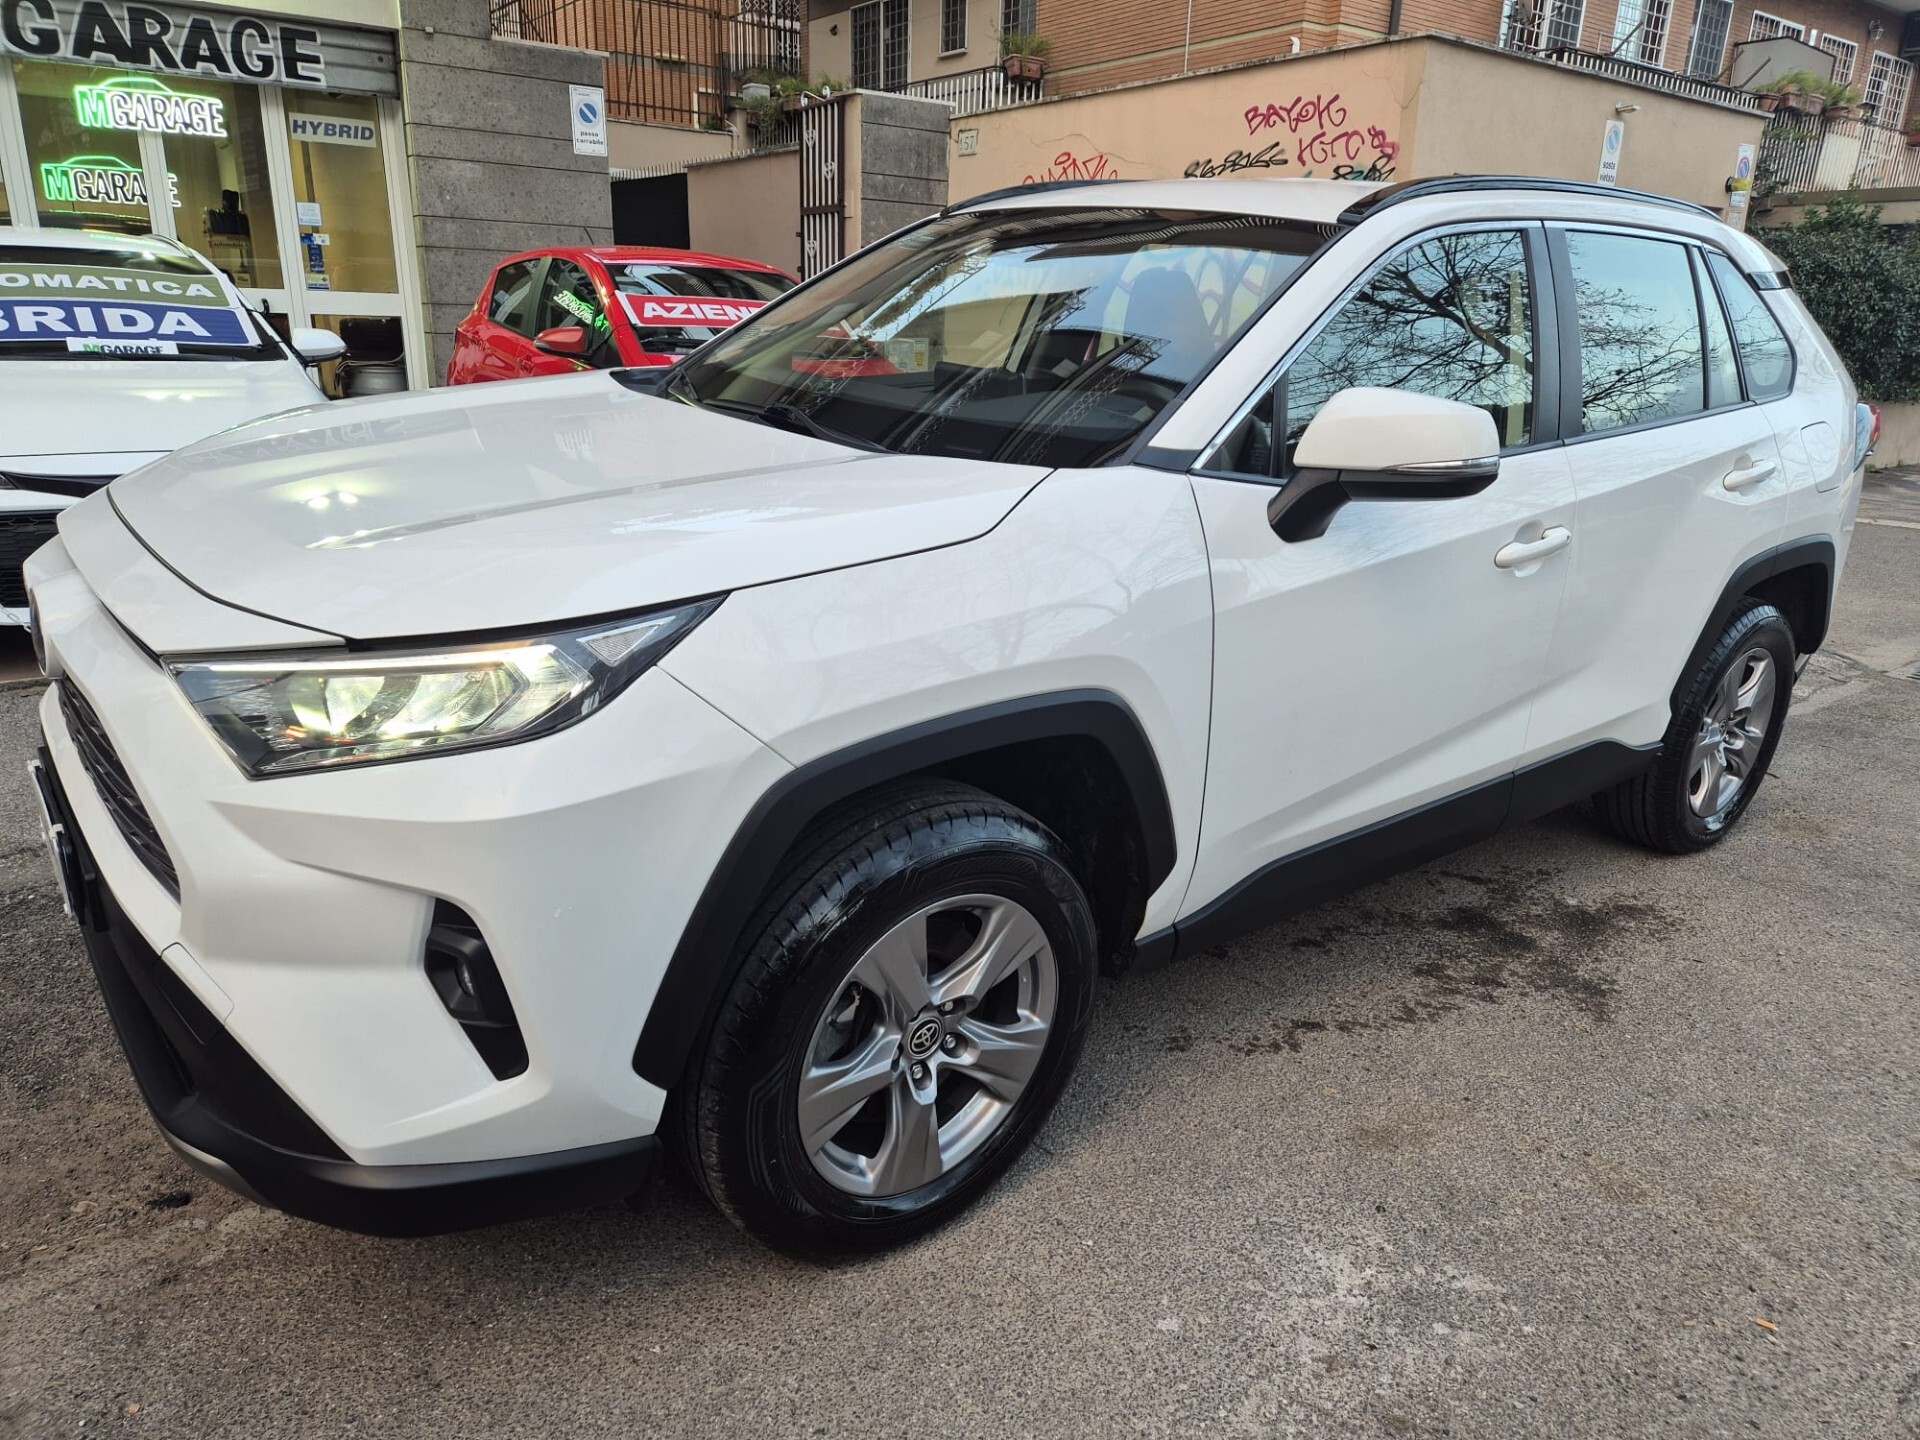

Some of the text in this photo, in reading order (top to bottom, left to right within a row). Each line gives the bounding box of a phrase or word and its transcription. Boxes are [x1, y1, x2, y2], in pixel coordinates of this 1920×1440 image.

[2, 0, 326, 86] GARAGE
[74, 86, 228, 138] MGARAGE
[292, 119, 374, 140] HYBRID
[1602, 161, 1616, 170] sosta
[41, 165, 182, 207] MGARAE
[0, 306, 212, 336] RIDA
[83, 344, 163, 354] MGARAGE
